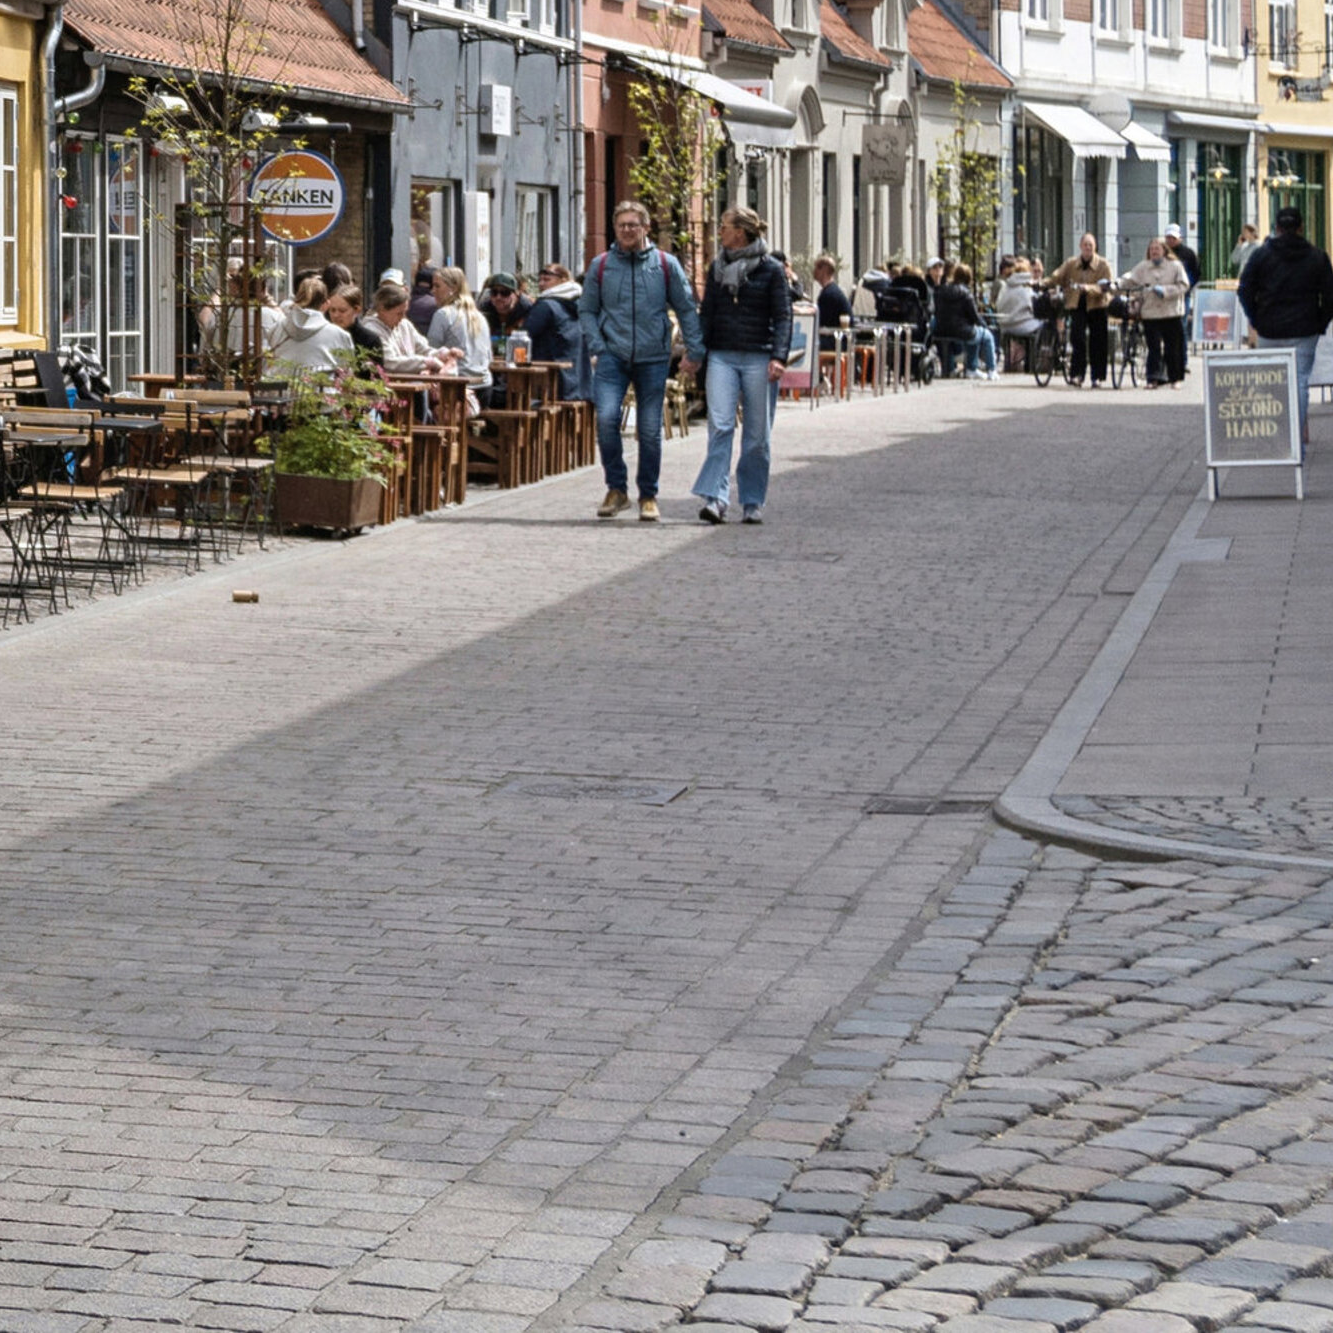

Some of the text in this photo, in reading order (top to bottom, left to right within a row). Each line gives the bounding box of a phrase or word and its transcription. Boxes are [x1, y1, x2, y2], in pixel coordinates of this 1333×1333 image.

[259, 189, 333, 204] TANKEN
[1218, 400, 1283, 419] SECOND
[1226, 420, 1278, 438] HAND
